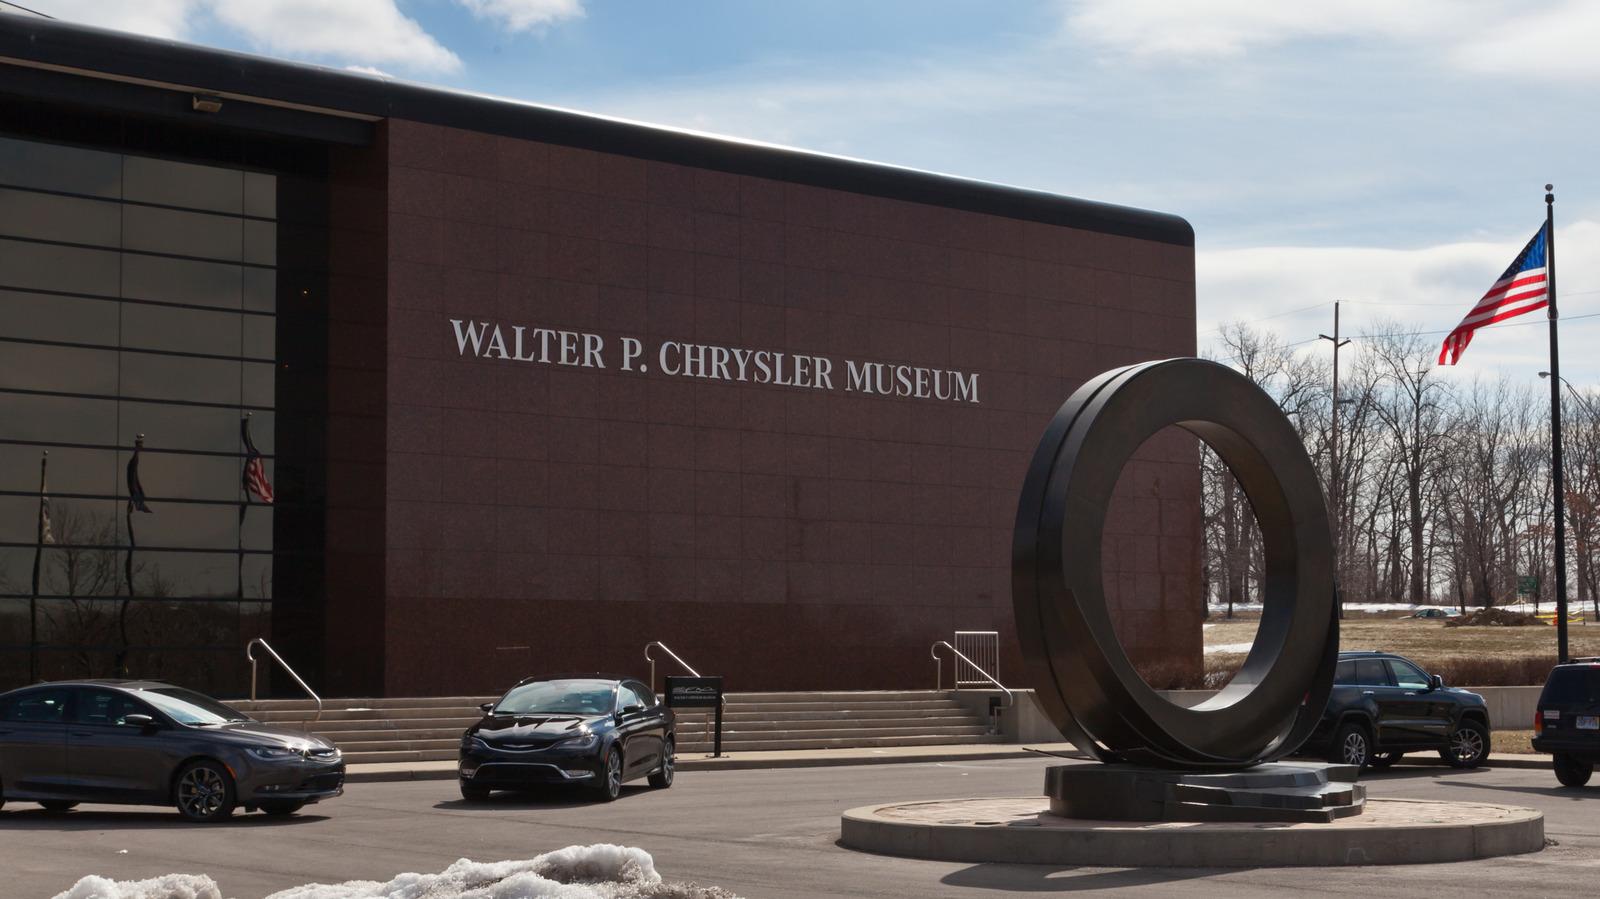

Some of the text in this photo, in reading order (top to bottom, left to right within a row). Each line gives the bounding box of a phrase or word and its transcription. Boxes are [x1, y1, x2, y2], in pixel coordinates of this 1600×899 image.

[449, 319, 980, 403] WALTER P. CHRYSLER MUSEUM
